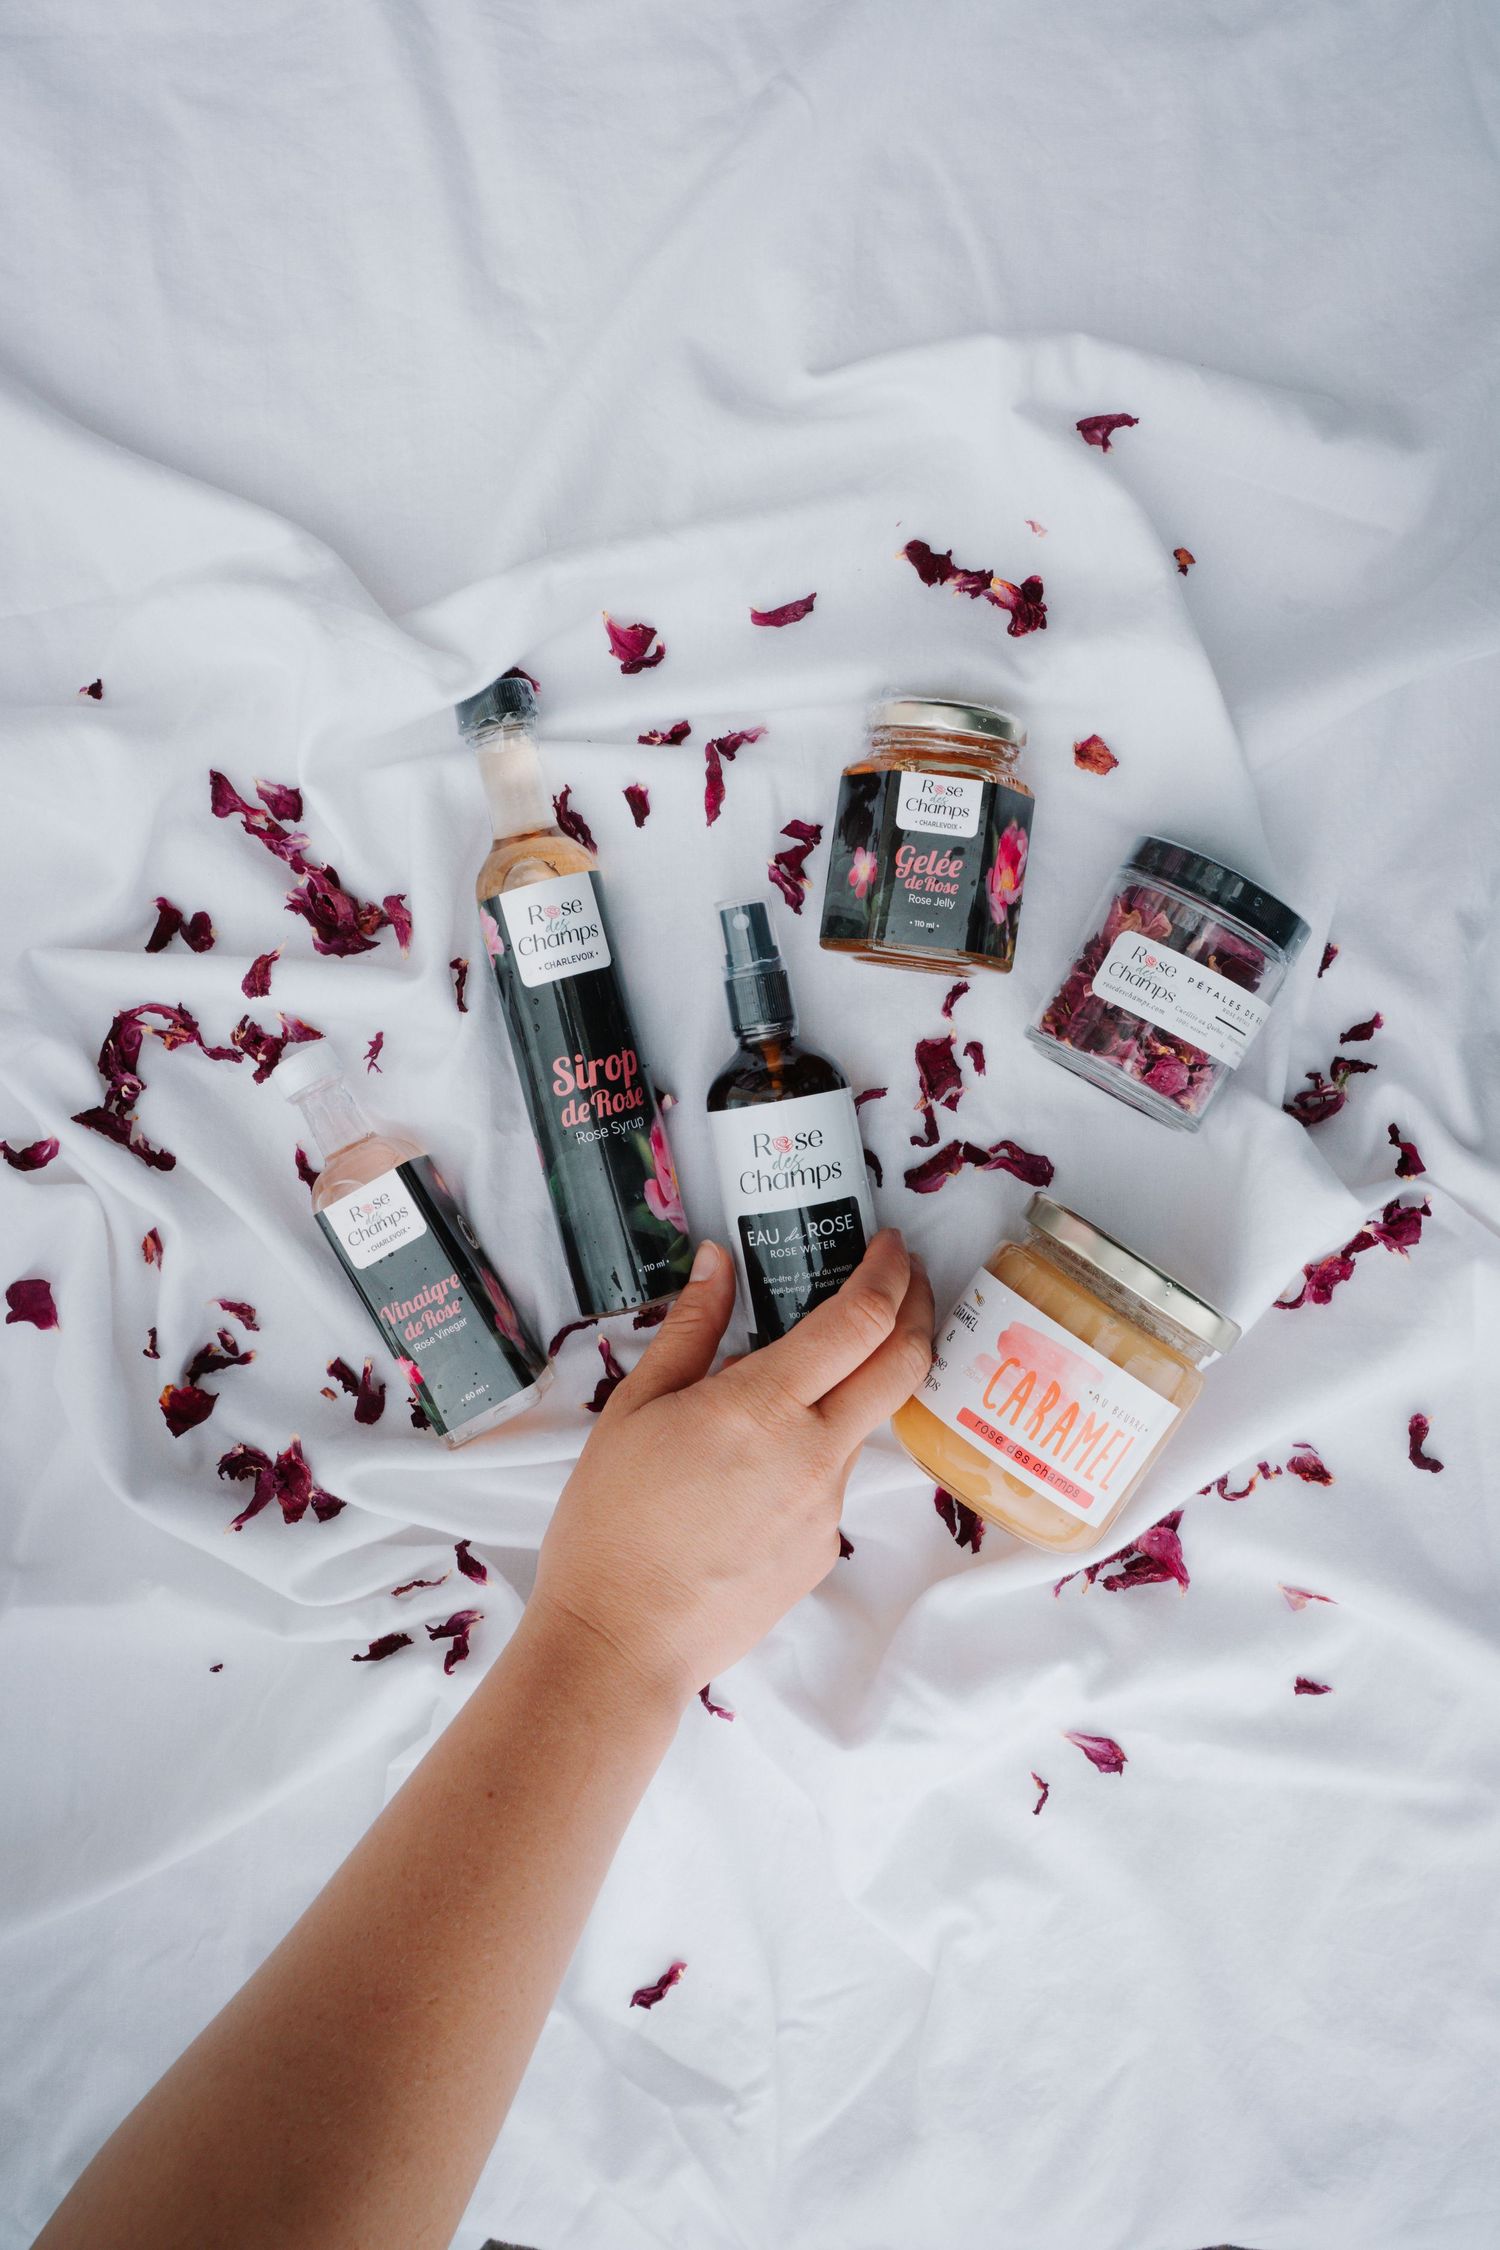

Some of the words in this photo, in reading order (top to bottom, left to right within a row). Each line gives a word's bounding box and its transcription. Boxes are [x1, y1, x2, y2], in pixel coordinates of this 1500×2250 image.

[922, 779, 964, 798] Rose
[905, 797, 970, 819] Champs
[919, 820, 958, 830] CHARLEVOIX
[895, 845, 963, 878] Gelée
[905, 876, 923, 891] de
[923, 876, 959, 895] Rose
[527, 898, 583, 925] Rose
[908, 894, 931, 906] Rose
[934, 897, 956, 910] Jelly
[518, 921, 599, 956] Champs
[914, 919, 925, 928] 110
[925, 920, 935, 929] ml
[544, 952, 595, 971] CHARLEVOIX
[1131, 945, 1177, 978] Rose
[1108, 961, 1177, 1003] Champs
[1244, 1009, 1255, 1020] DE
[552, 1048, 637, 1096] Sirop
[561, 1100, 590, 1128] de
[590, 1086, 644, 1119] Rose
[576, 1126, 609, 1145] Rose
[611, 1115, 645, 1138] Syrup
[752, 1129, 823, 1158] Rose
[740, 1160, 842, 1194] Champs
[349, 1192, 390, 1223] Rose
[347, 1206, 409, 1246] Champs
[371, 1228, 407, 1252] CHARLEVOIX
[747, 1229, 780, 1247] EAU
[806, 1213, 854, 1238] ROSE
[770, 1248, 798, 1259] ROSE
[799, 1239, 837, 1254] WATER
[643, 1262, 655, 1273] 110
[656, 1259, 666, 1270] ml
[763, 1274, 792, 1284] Bien-être
[801, 1270, 820, 1280] Soins
[822, 1268, 831, 1276] du
[815, 1278, 834, 1289] Facial
[379, 1273, 461, 1326] Vinaigre
[403, 1321, 424, 1341] de
[421, 1300, 462, 1330] Rose
[952, 1304, 978, 1332] CARAMEL
[413, 1333, 436, 1353] Rose
[434, 1317, 468, 1341] Vinegar
[946, 1329, 955, 1342] &
[475, 1386, 486, 1396] ml
[982, 1358, 1135, 1491] CARAMEL
[1092, 1392, 1108, 1409] AU
[1112, 1405, 1145, 1433] BEURRE
[975, 1418, 1004, 1445] rose
[1006, 1441, 1030, 1464] des
[1032, 1460, 1081, 1498] champs
